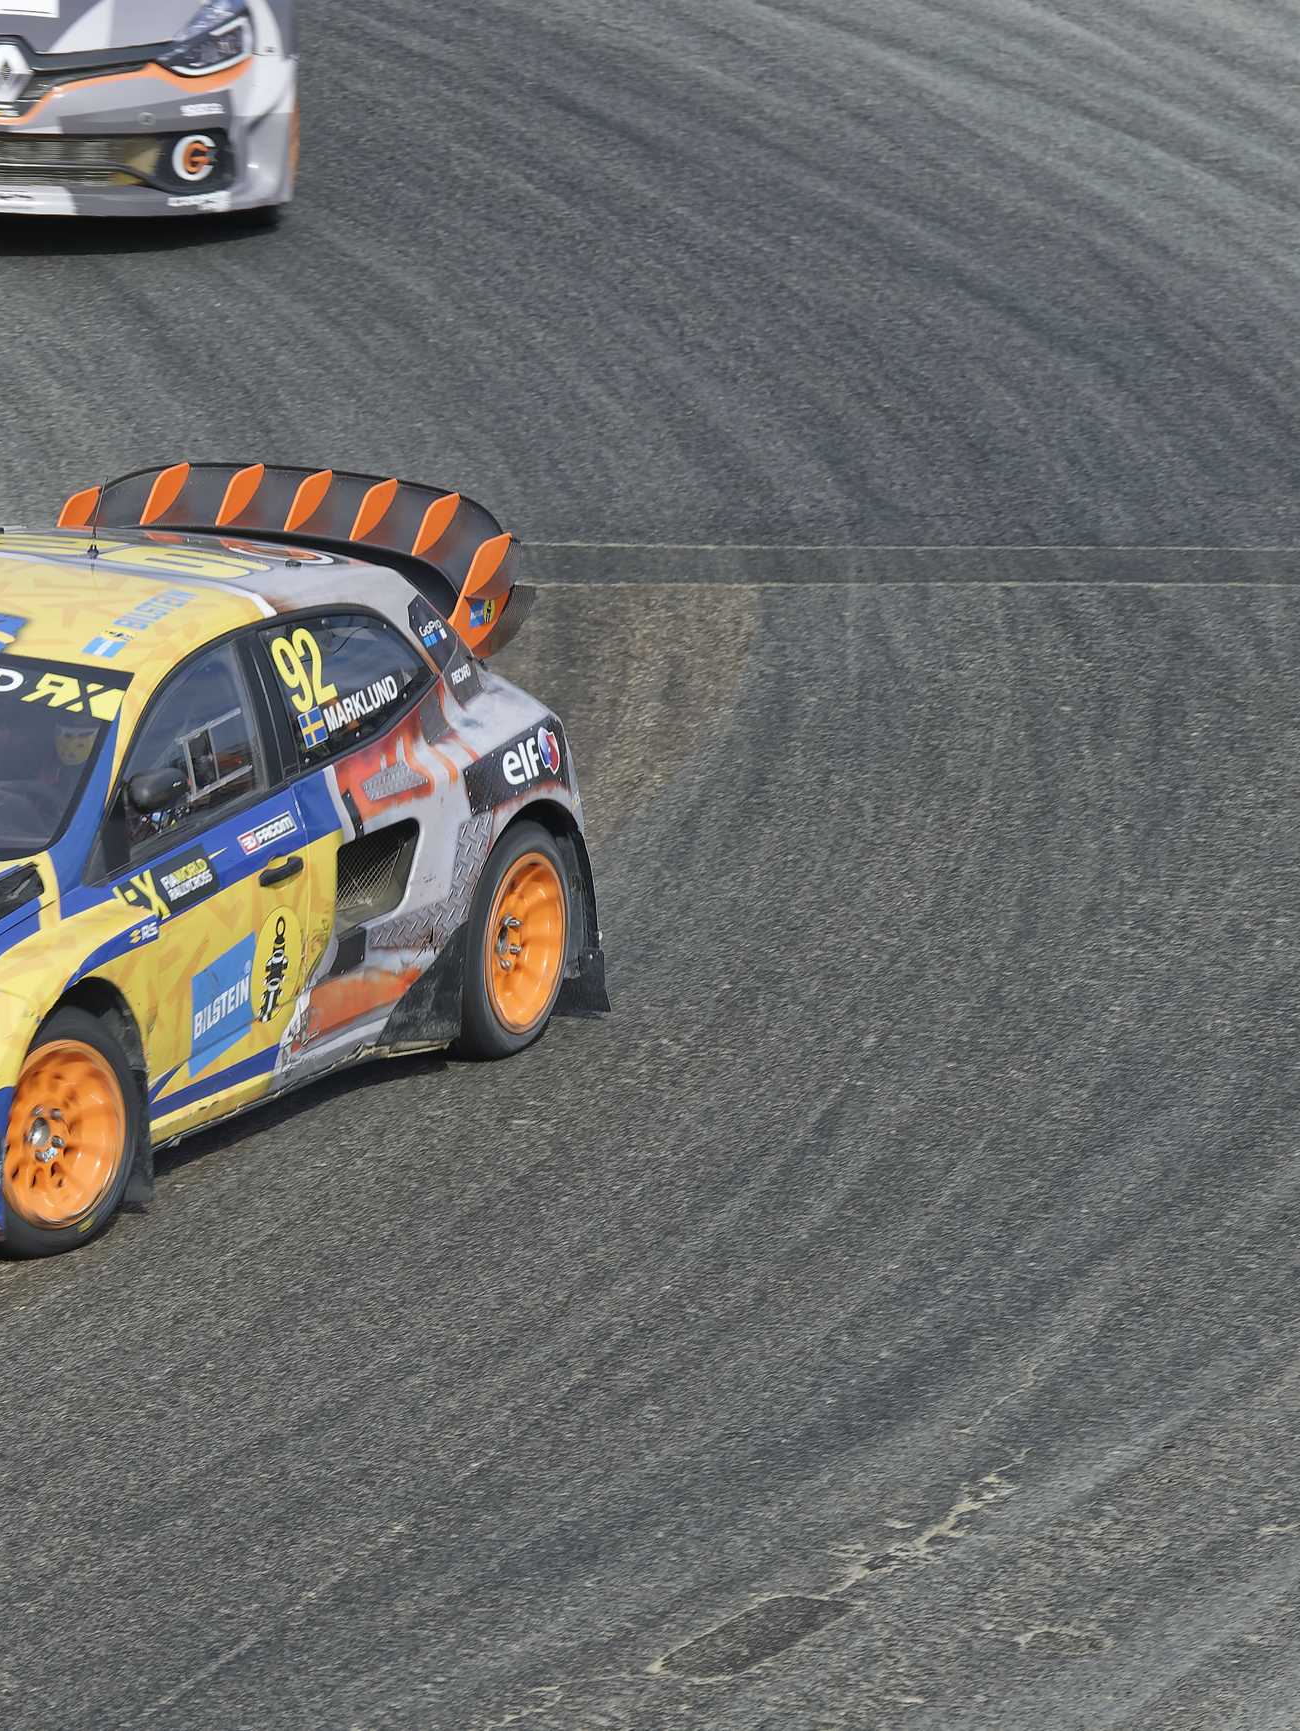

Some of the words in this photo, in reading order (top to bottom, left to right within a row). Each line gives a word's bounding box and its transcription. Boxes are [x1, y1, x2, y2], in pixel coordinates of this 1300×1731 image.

[419, 619, 442, 637] GoPro
[271, 628, 338, 713] 92
[451, 663, 471, 686] RECARO
[322, 675, 398, 732] MARKLUND
[502, 737, 540, 786] elf
[141, 921, 159, 941] RS
[193, 974, 250, 1041] BILSTEIN
